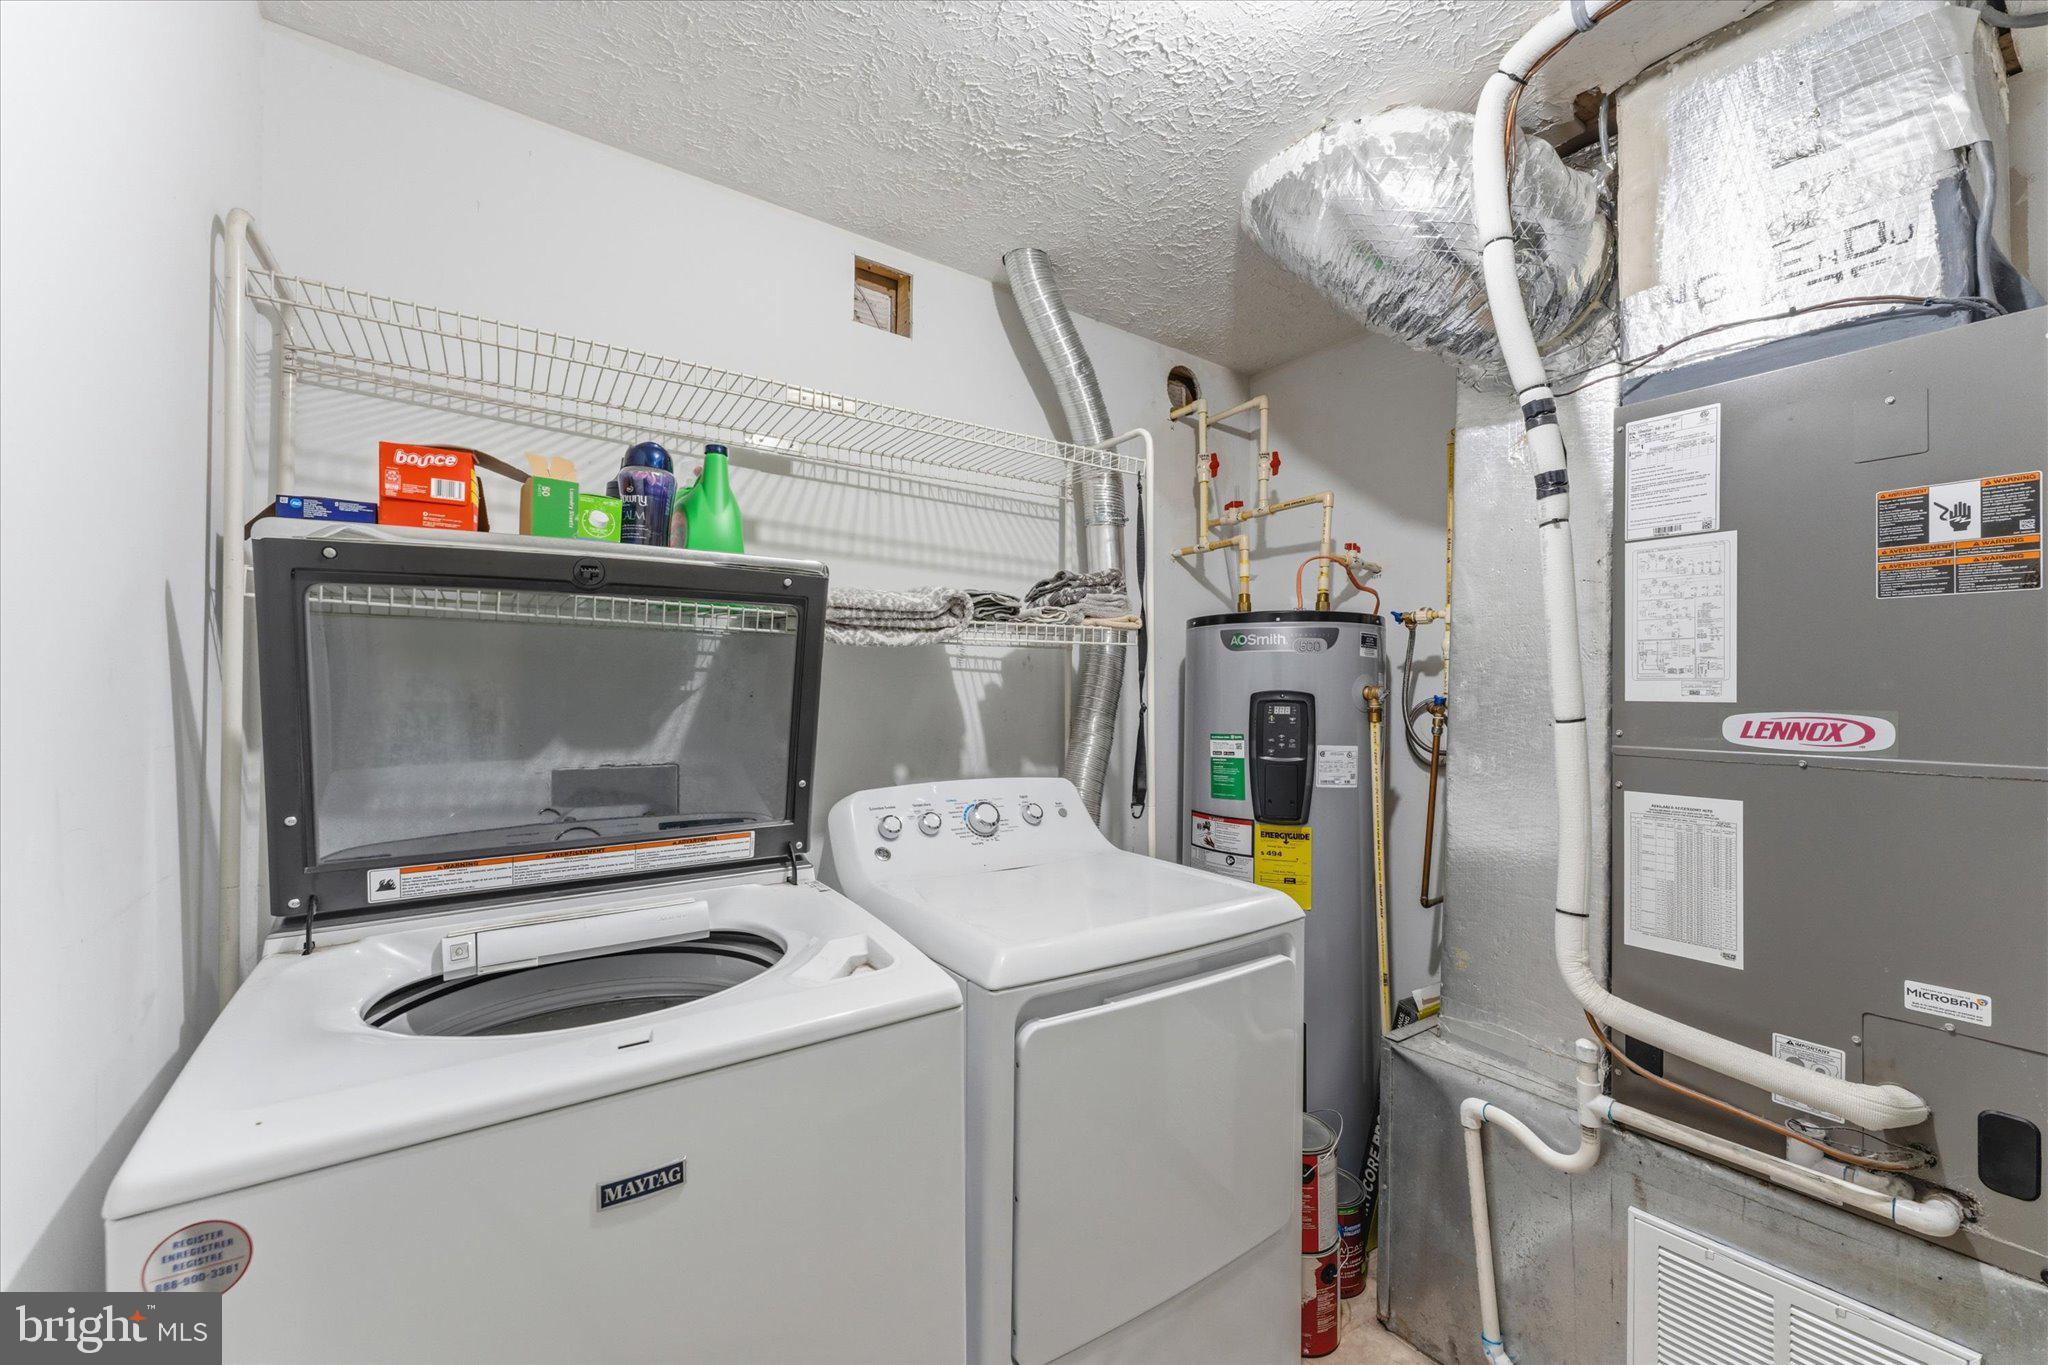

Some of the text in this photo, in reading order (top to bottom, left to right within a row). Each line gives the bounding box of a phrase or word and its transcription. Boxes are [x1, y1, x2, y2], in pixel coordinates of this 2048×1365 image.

[394, 448, 458, 468] bounce
[1993, 473, 2036, 485] WARNING
[1982, 537, 2025, 546] WARNING
[1982, 553, 2025, 562] WARNING
[1739, 720, 1848, 742] LENNOX
[443, 861, 479, 870] WARNING
[1362, 1146, 1380, 1193] CORE
[603, 1166, 681, 1204] MAYTAG
[172, 1229, 224, 1250] REGISTER
